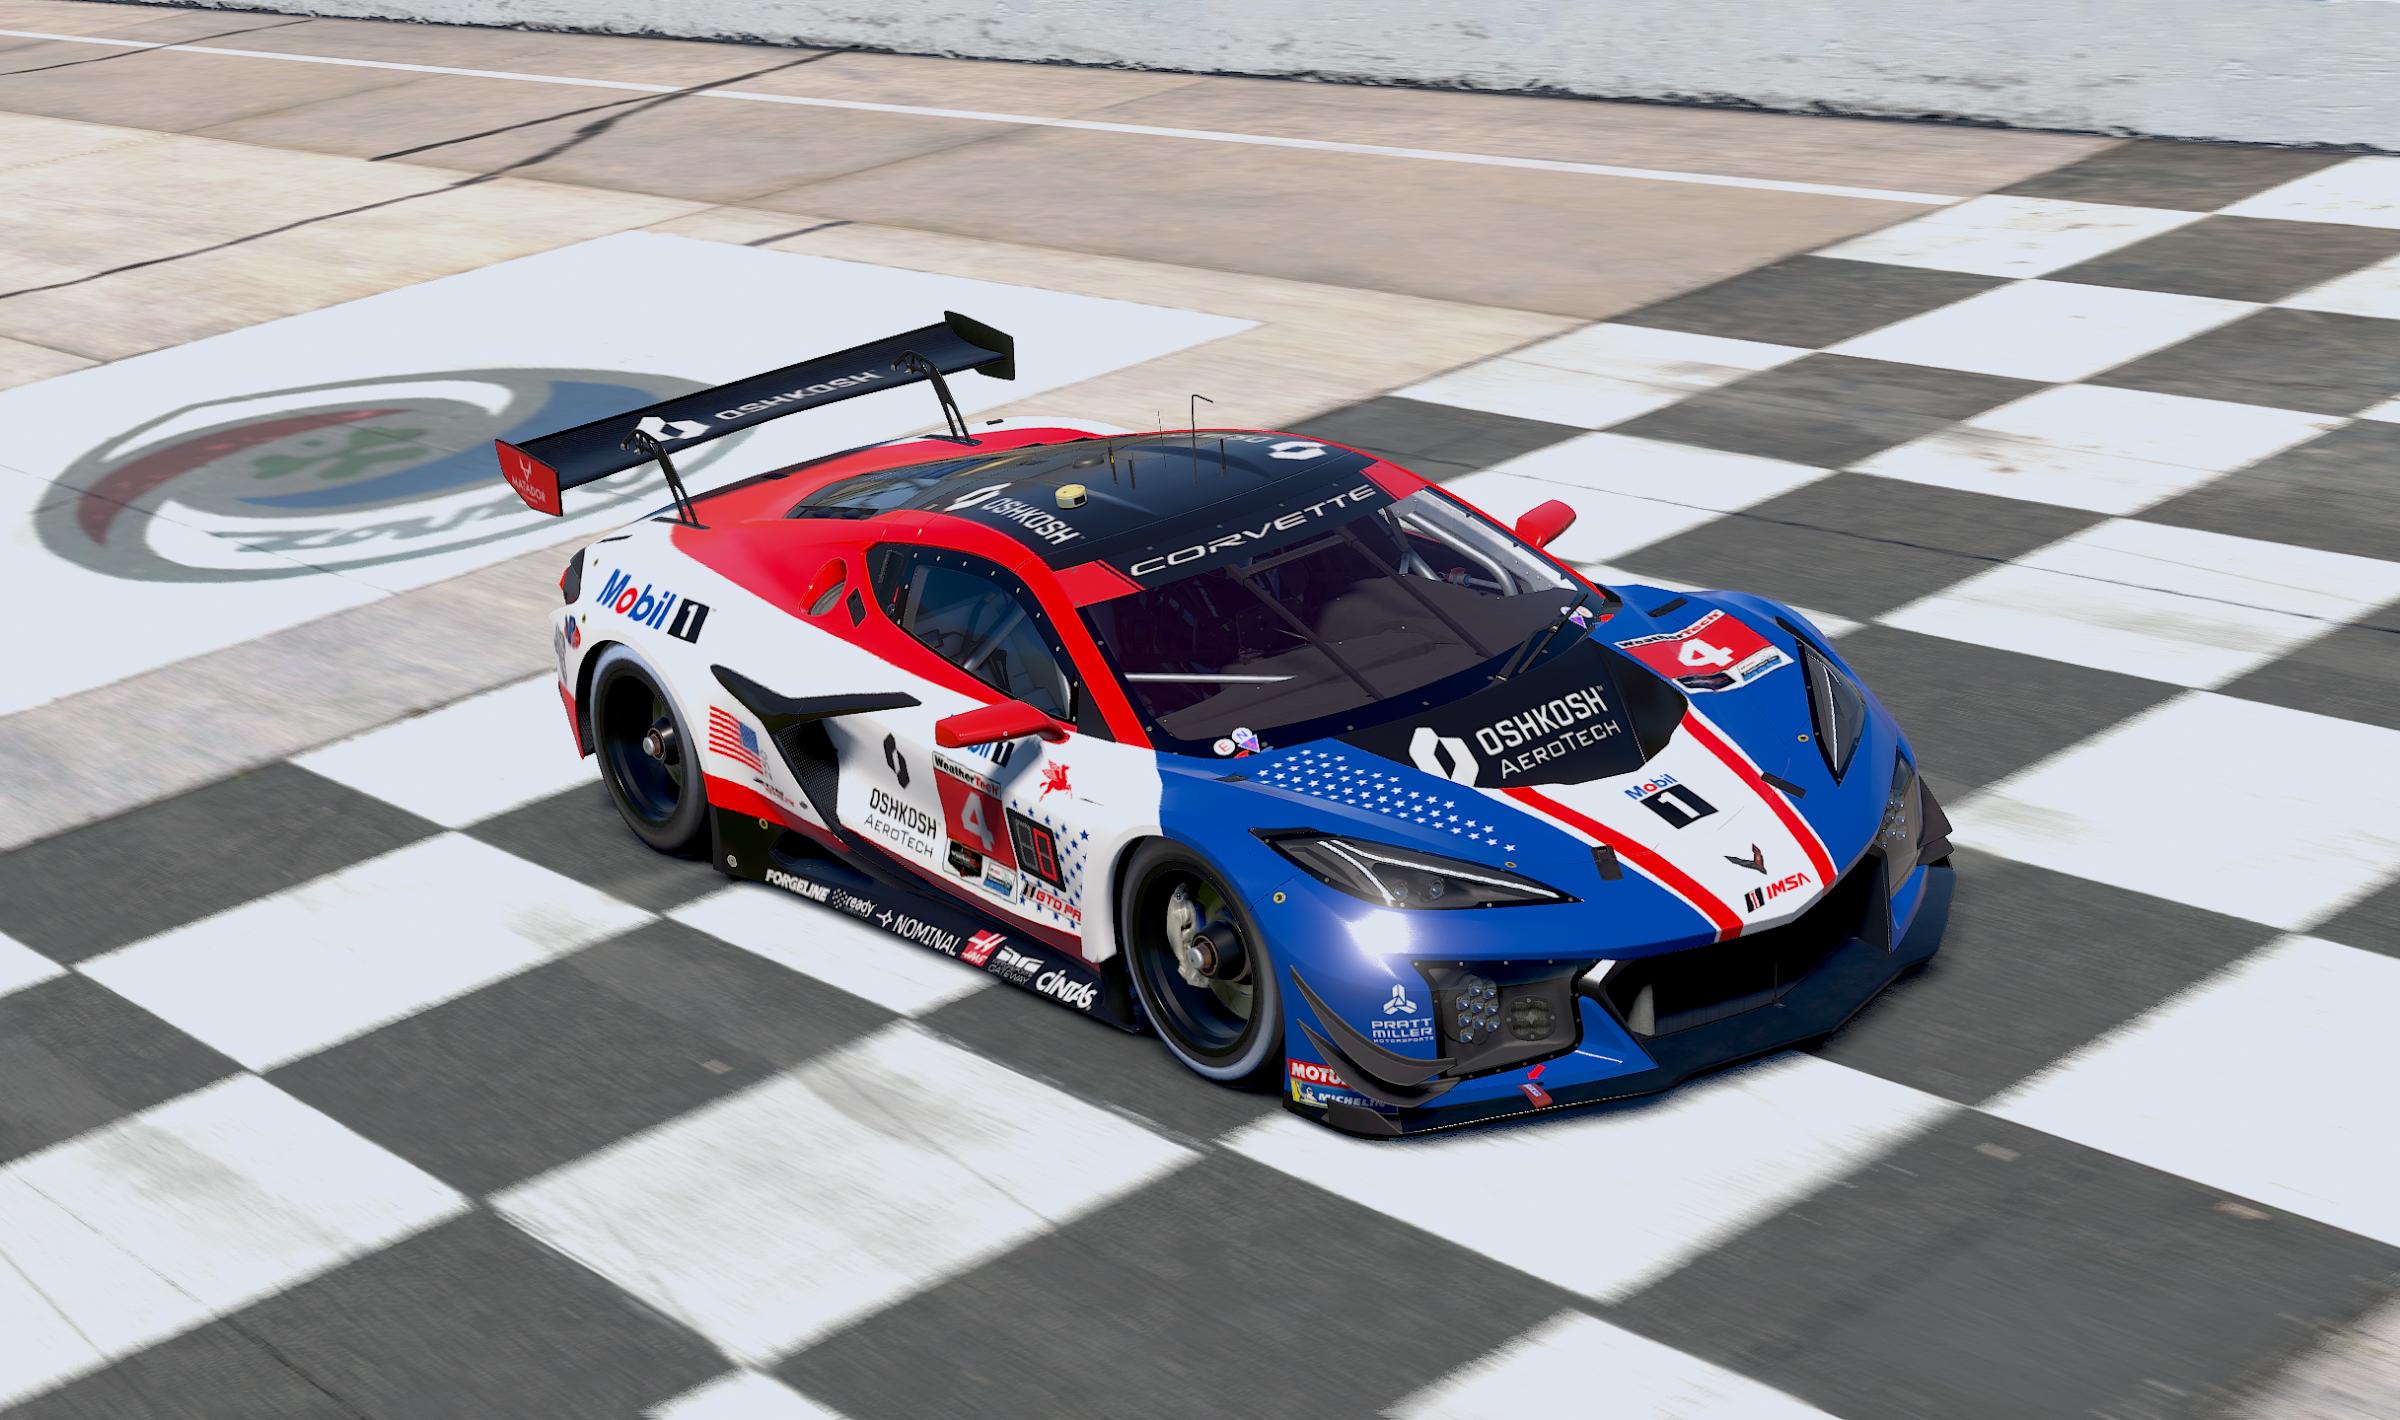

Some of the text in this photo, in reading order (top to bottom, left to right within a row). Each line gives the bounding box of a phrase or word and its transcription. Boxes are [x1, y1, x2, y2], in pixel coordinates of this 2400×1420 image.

[714, 371, 885, 420] OSHKOSH
[511, 474, 546, 502] MATADOR
[981, 497, 1080, 545] OSHKOSH
[1130, 484, 1376, 577] CORVETTE
[596, 569, 677, 630] Mobil
[1678, 638, 1735, 667] 4
[1475, 686, 1608, 756] OSHKOSH
[1624, 774, 1678, 800] Mobil
[870, 788, 936, 840] OSHKOSH
[961, 791, 996, 852] 4
[765, 869, 831, 903] FORGELINE
[1036, 889, 1062, 911] GTD
[1766, 872, 1811, 901] IMSA
[846, 896, 875, 918] ready
[892, 914, 961, 957] NOMINAL
[1371, 1017, 1432, 1030] PRATT
[1372, 1028, 1433, 1039] MILLER
[1291, 1062, 1348, 1086] MOTU
